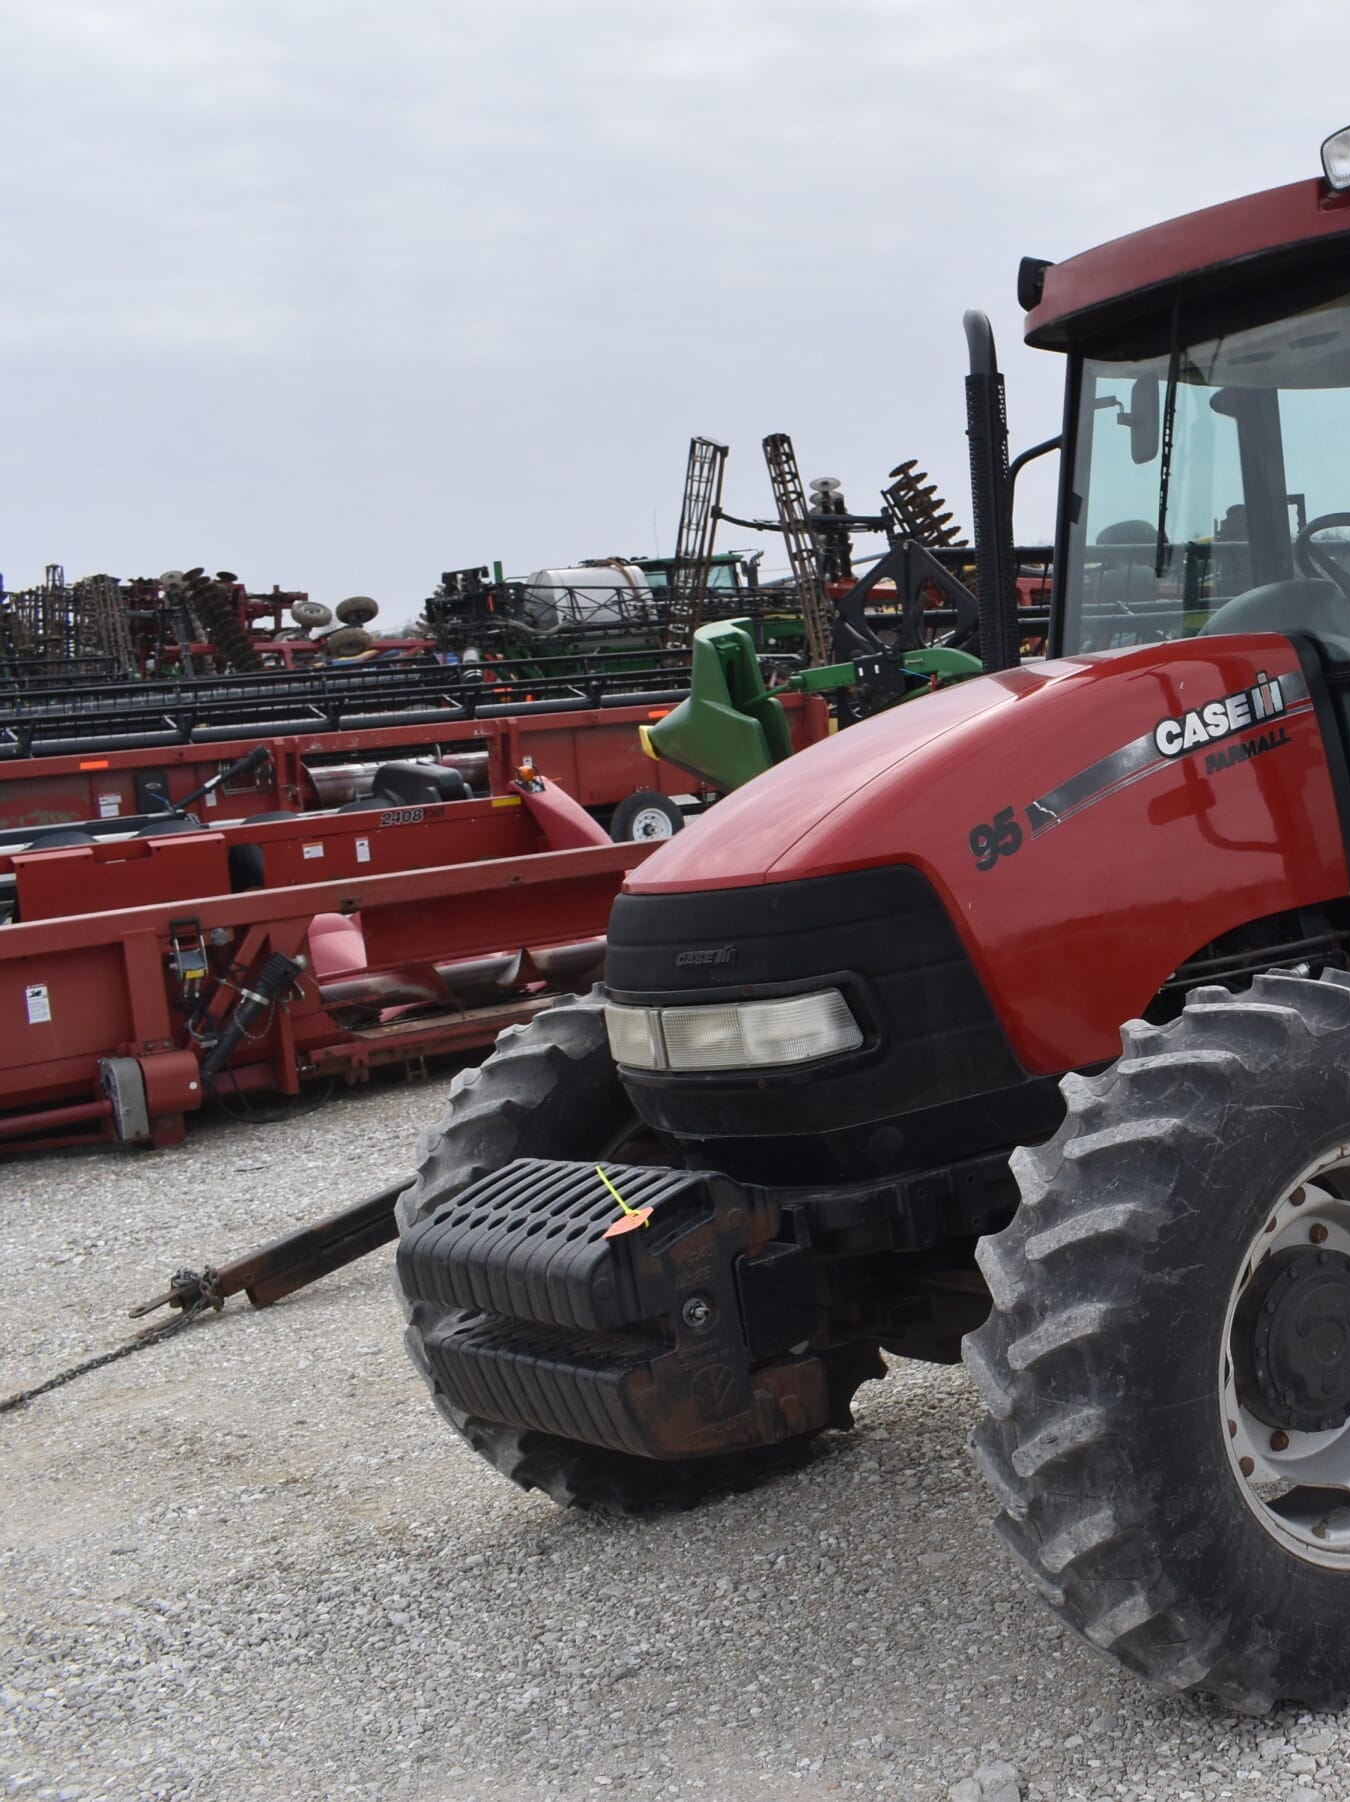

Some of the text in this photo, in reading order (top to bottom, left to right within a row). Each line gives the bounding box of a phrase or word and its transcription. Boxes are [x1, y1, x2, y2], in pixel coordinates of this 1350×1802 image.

[1155, 691, 1251, 756] CASE
[1204, 726, 1292, 776] FARMALL
[379, 806, 424, 828] 2408
[968, 805, 1023, 872] 95
[676, 949, 713, 966] CASE
